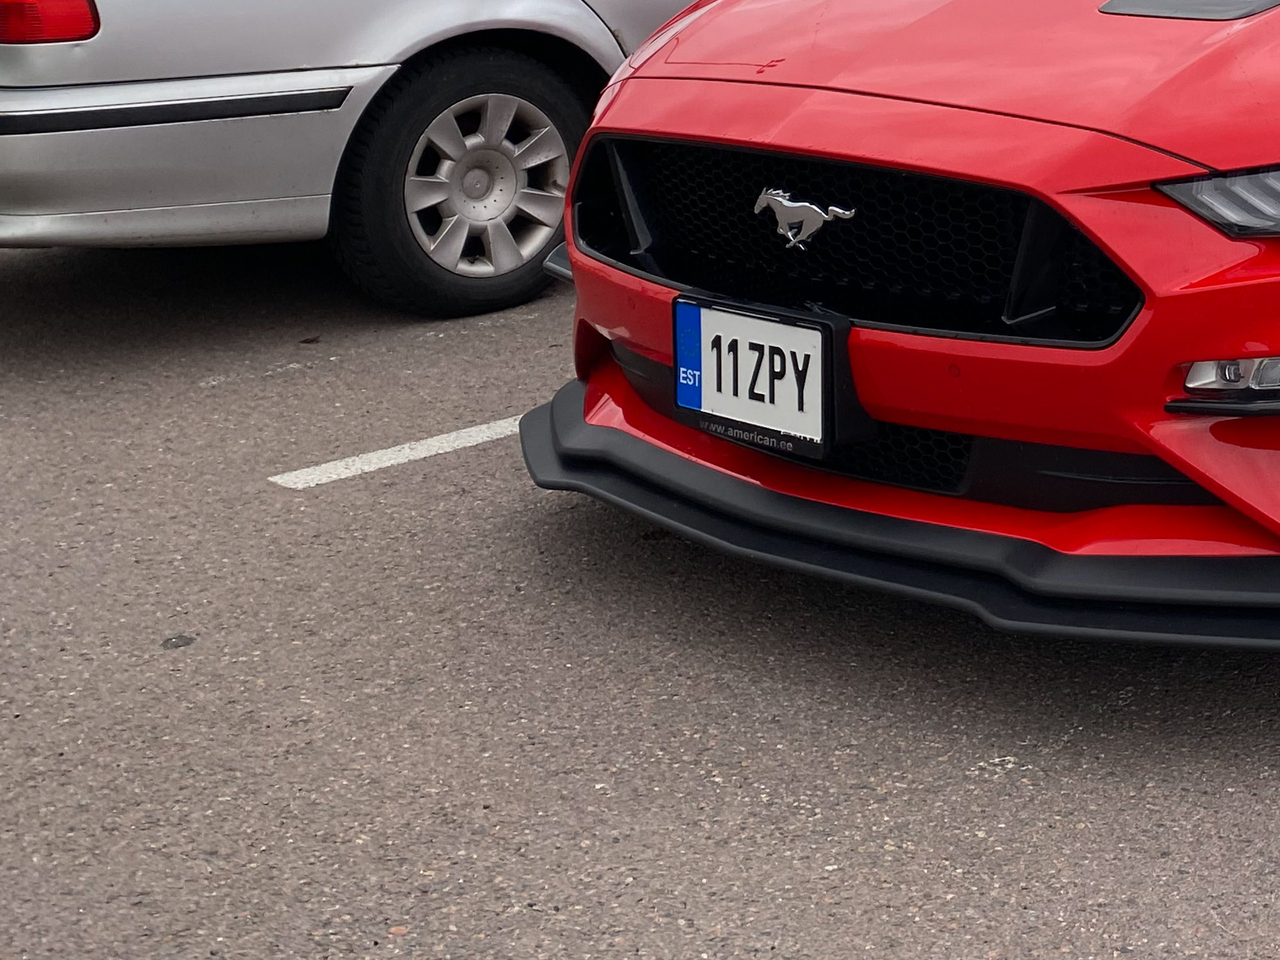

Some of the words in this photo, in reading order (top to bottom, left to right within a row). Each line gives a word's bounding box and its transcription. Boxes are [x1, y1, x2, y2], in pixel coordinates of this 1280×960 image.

[679, 367, 701, 387] EST
[711, 334, 811, 412] 11ZPY
[700, 420, 793, 451] www.american.ee
